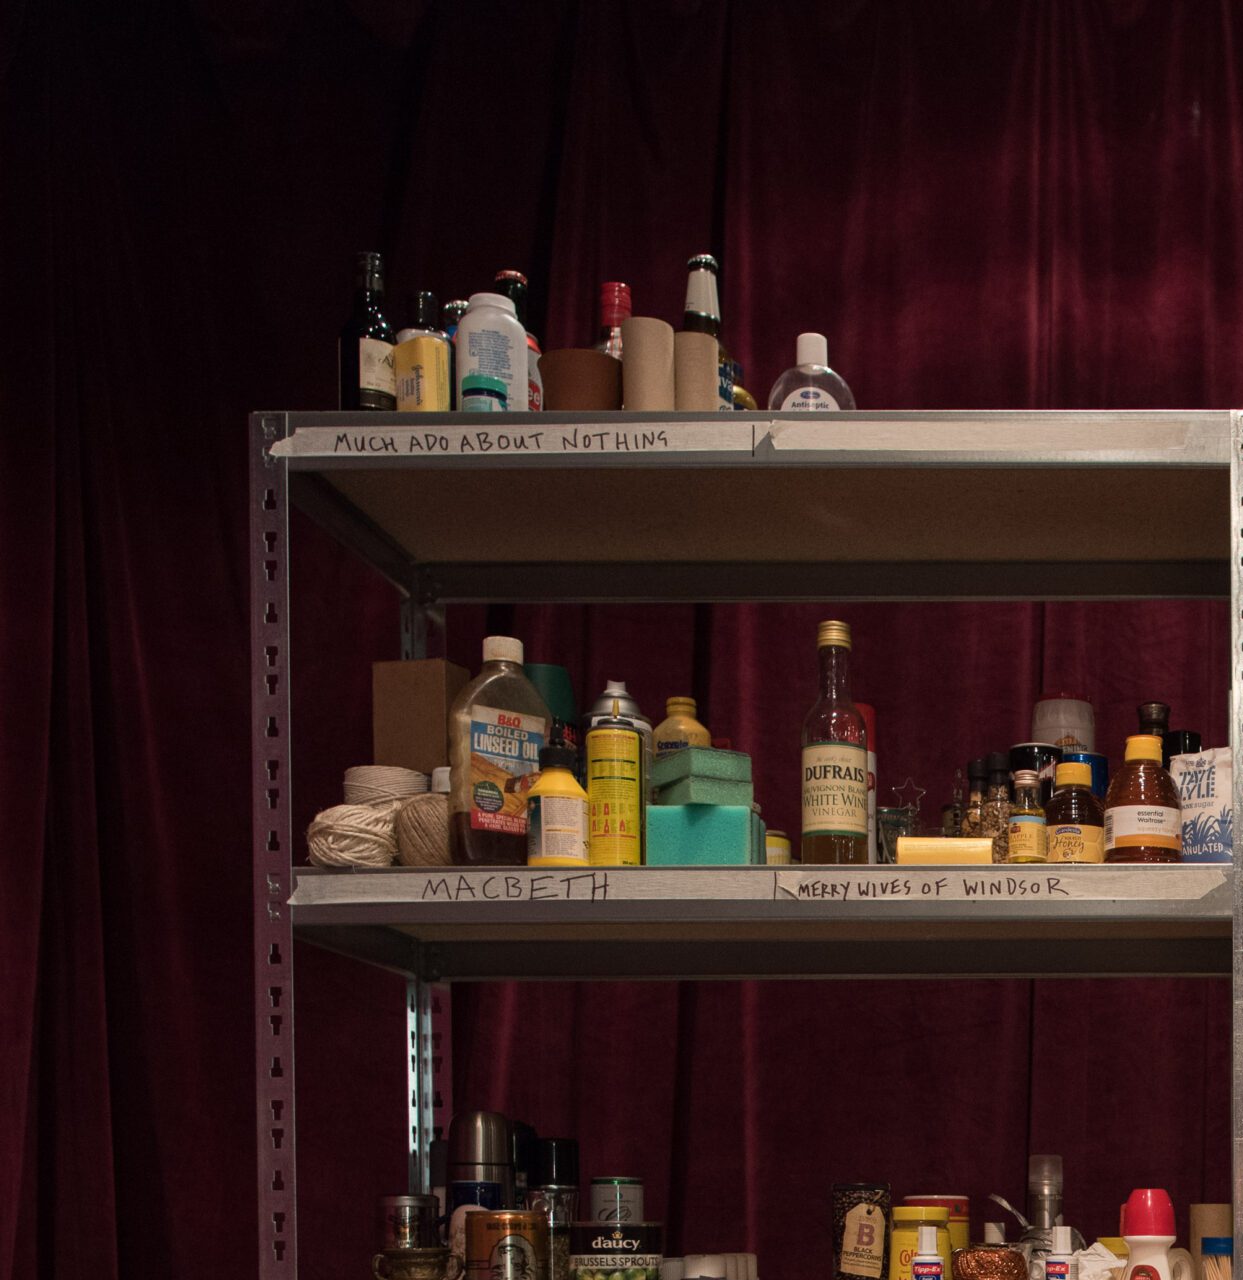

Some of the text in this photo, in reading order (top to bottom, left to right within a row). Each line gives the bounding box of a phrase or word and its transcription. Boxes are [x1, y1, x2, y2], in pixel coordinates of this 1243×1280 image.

[791, 400, 830, 410] Antiseptic
[334, 428, 667, 453] MUCH ADO ABOUT NOTHING
[497, 714, 521, 728] B&Q
[486, 723, 529, 741] BOILED
[474, 732, 540, 760] LINSEED OIL
[805, 764, 864, 783] DUFRAIS
[1179, 764, 1215, 786] TATE
[803, 793, 838, 809] WHITE
[1194, 801, 1214, 810] sugar
[813, 808, 857, 818] VINEGAR
[1137, 809, 1164, 818] essential
[1137, 816, 1166, 825] Waitrose
[1053, 836, 1085, 853] Honey
[1182, 842, 1224, 857] ANULATED
[421, 872, 609, 904] MACBETH
[798, 877, 1070, 902] MERRY WIVES OF WINDSOR
[857, 1222, 875, 1246] B
[591, 1235, 641, 1252] d'aucy
[853, 1246, 873, 1254] BLACK
[574, 1256, 659, 1268] BRUSSELS SPROUTS
[842, 1250, 882, 1261] PEPPERCORNS
[914, 1265, 942, 1274] Tipp-Ex
